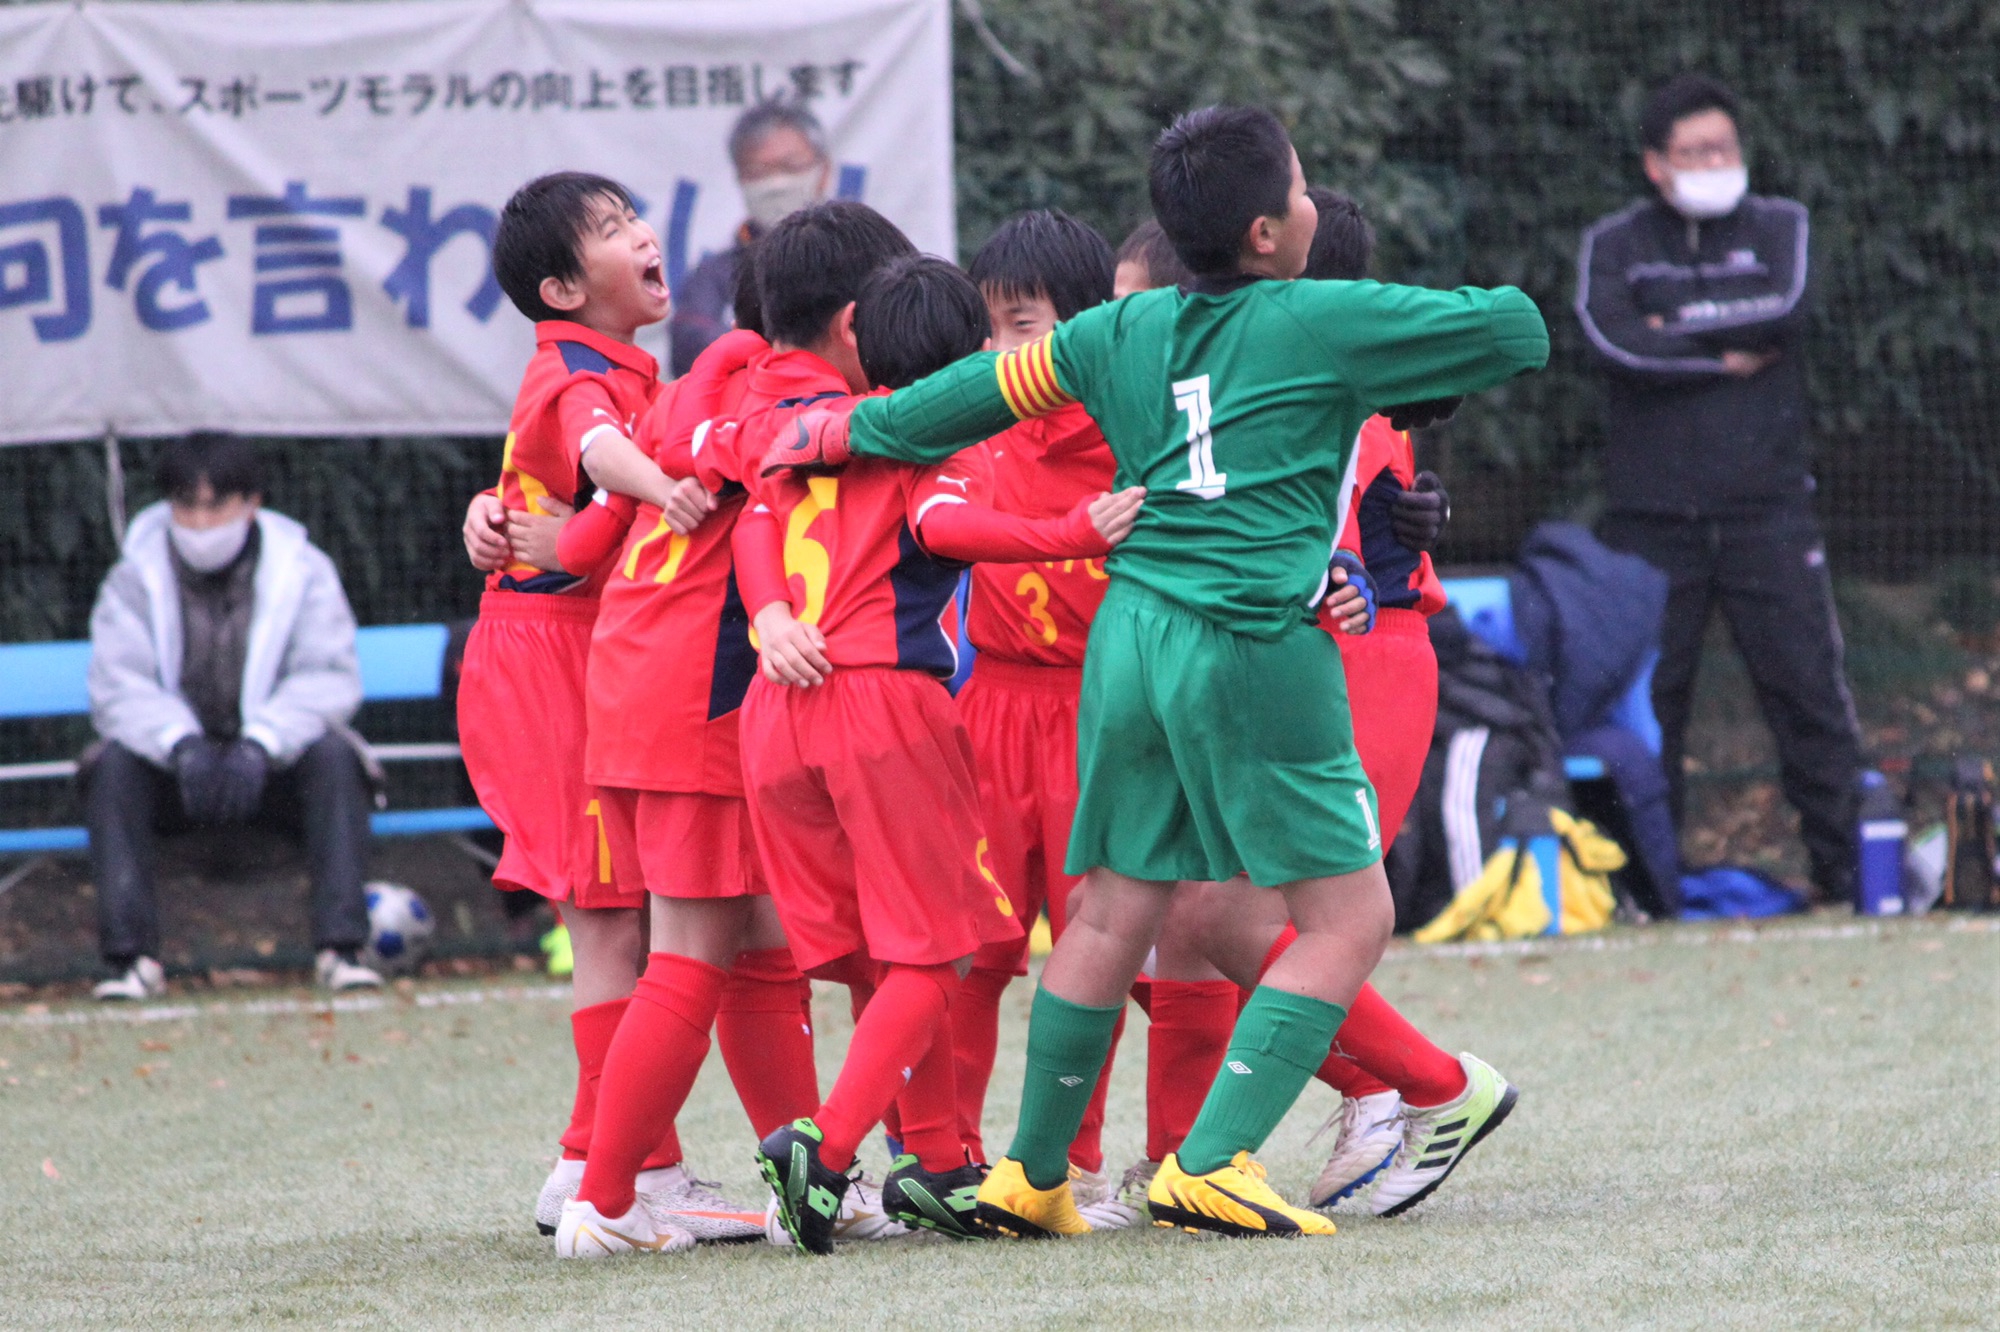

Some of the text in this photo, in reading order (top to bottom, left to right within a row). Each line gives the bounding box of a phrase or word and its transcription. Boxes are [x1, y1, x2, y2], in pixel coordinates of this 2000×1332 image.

[1171, 373, 1227, 501] 1
[1015, 571, 1058, 647] 3
[1355, 788, 1381, 851] 1
